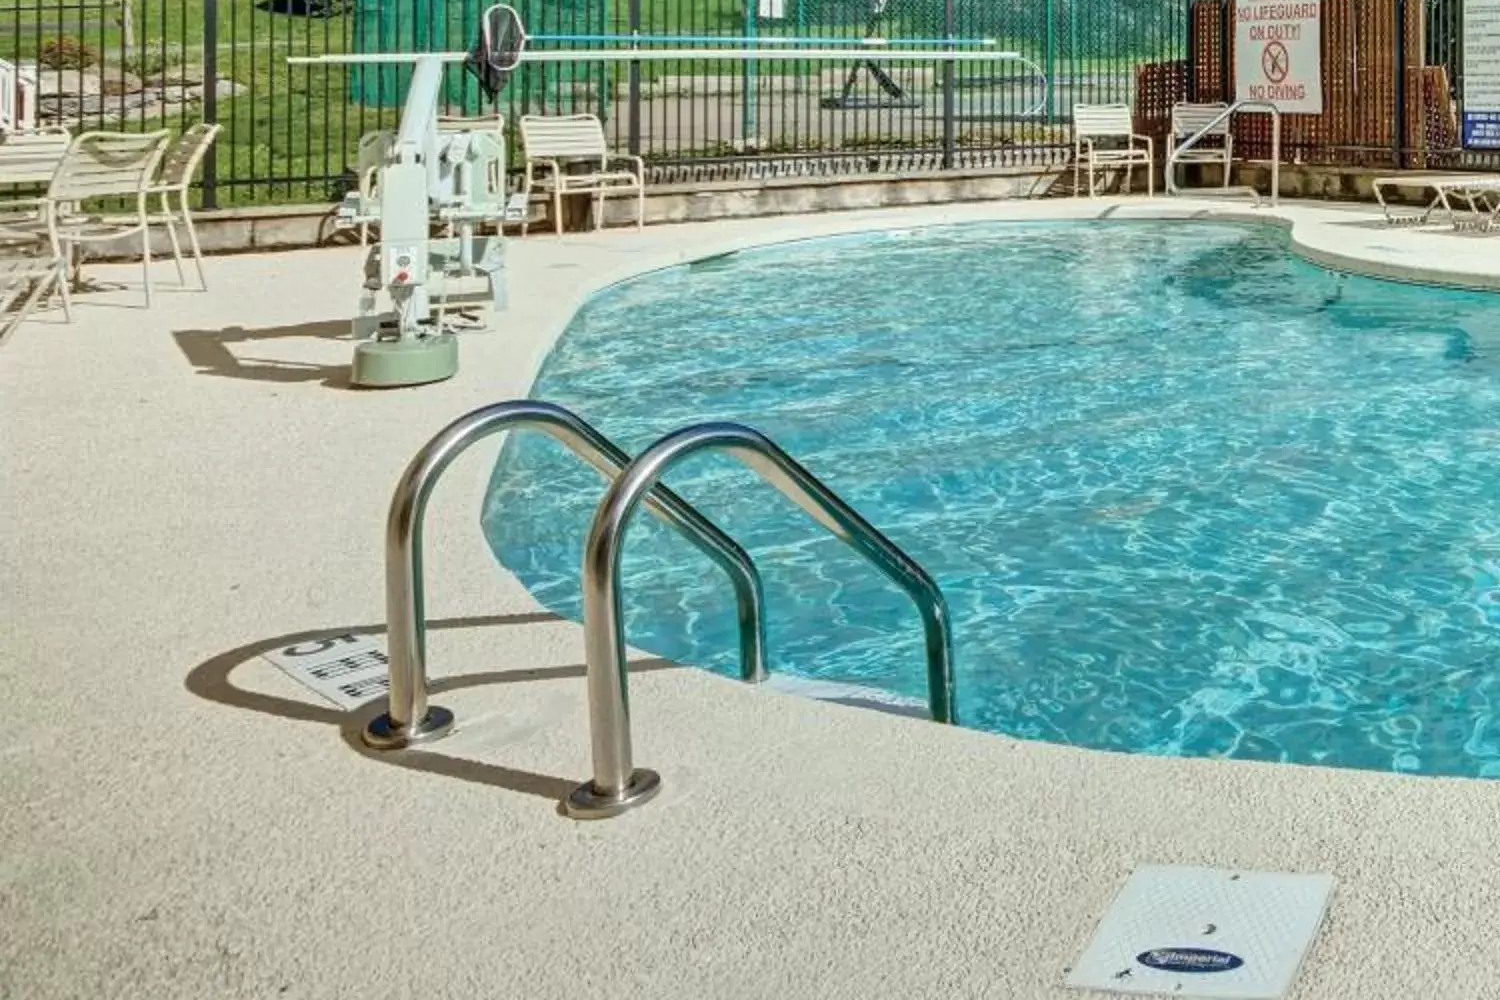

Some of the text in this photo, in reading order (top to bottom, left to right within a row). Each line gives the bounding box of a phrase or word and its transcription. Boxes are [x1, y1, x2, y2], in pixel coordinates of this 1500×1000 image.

[1253, 3, 1317, 20] LIFEGUARD
[1249, 25, 1265, 40] ON
[1249, 83, 1305, 100] NO DIVING
